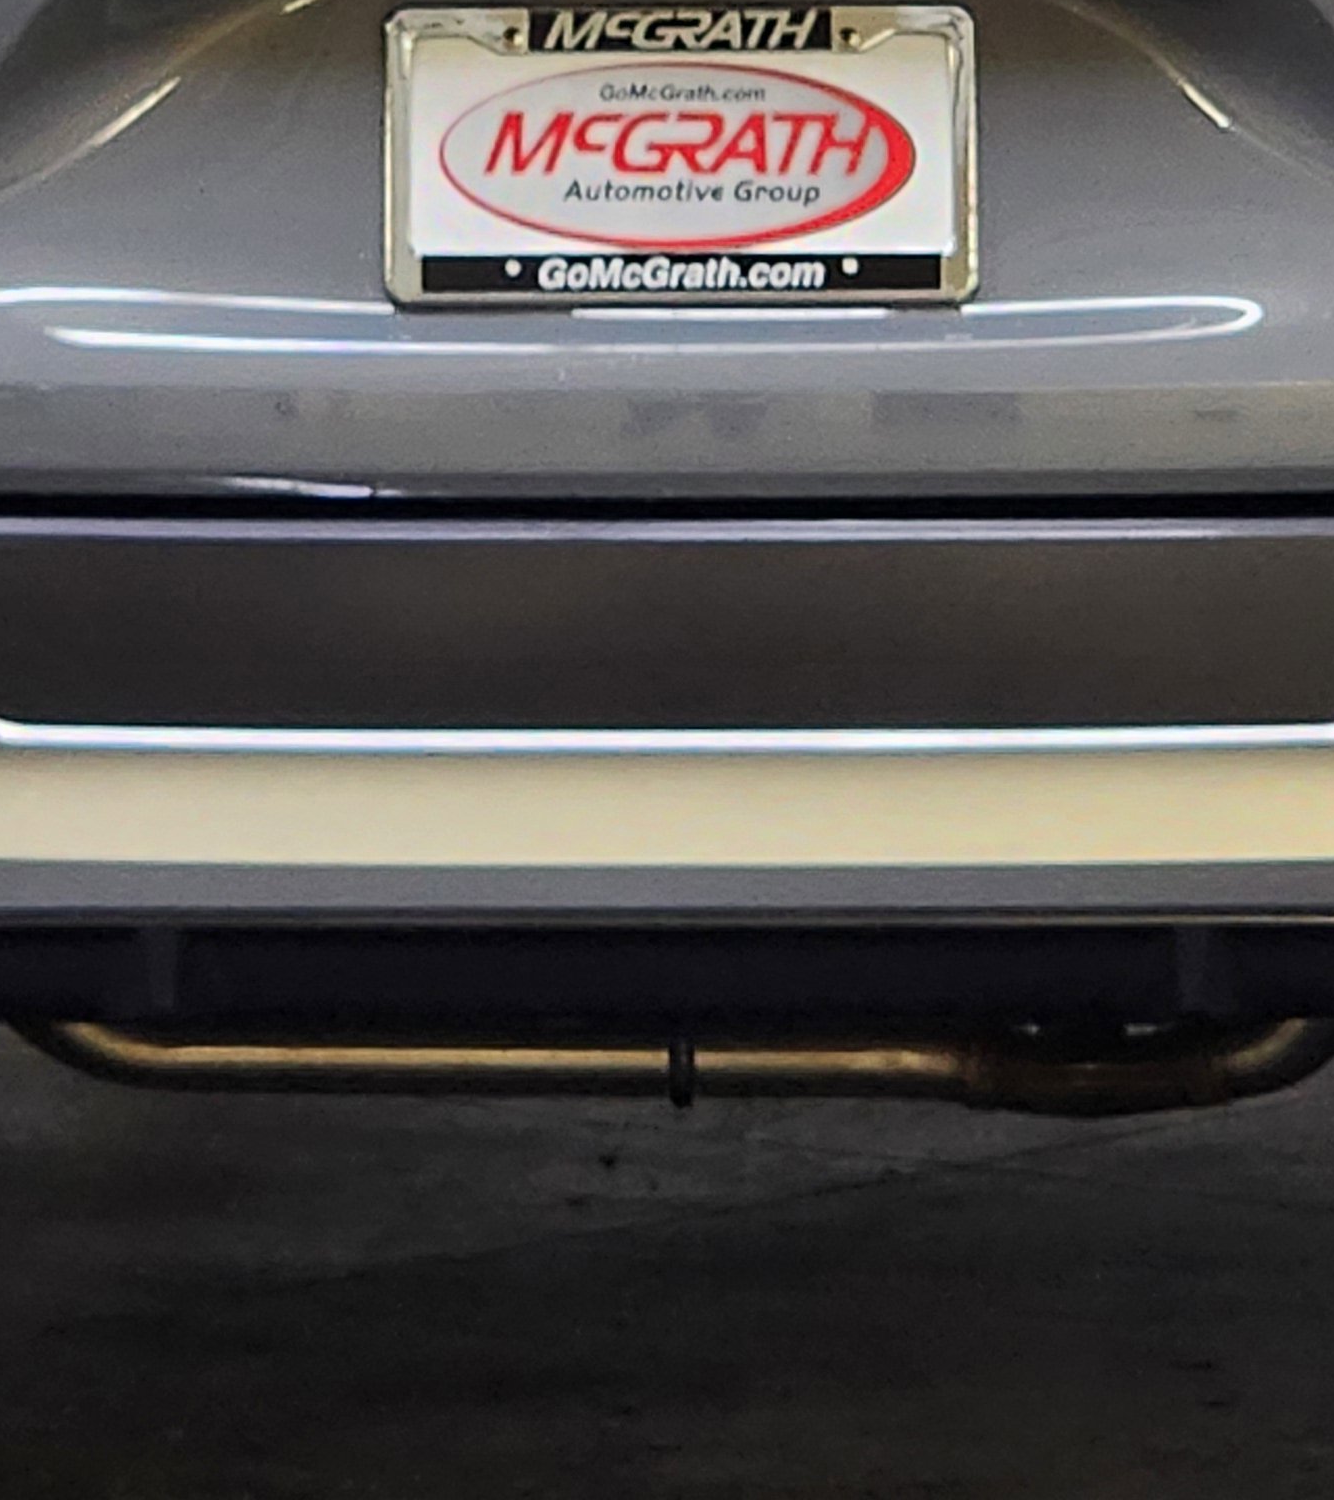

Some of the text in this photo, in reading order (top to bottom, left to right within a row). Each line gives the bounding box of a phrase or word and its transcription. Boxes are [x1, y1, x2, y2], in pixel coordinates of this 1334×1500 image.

[599, 83, 766, 102] GoMcGrath.com
[564, 179, 821, 207] Automotive Group
[537, 257, 825, 291] GoMcGrath.com
